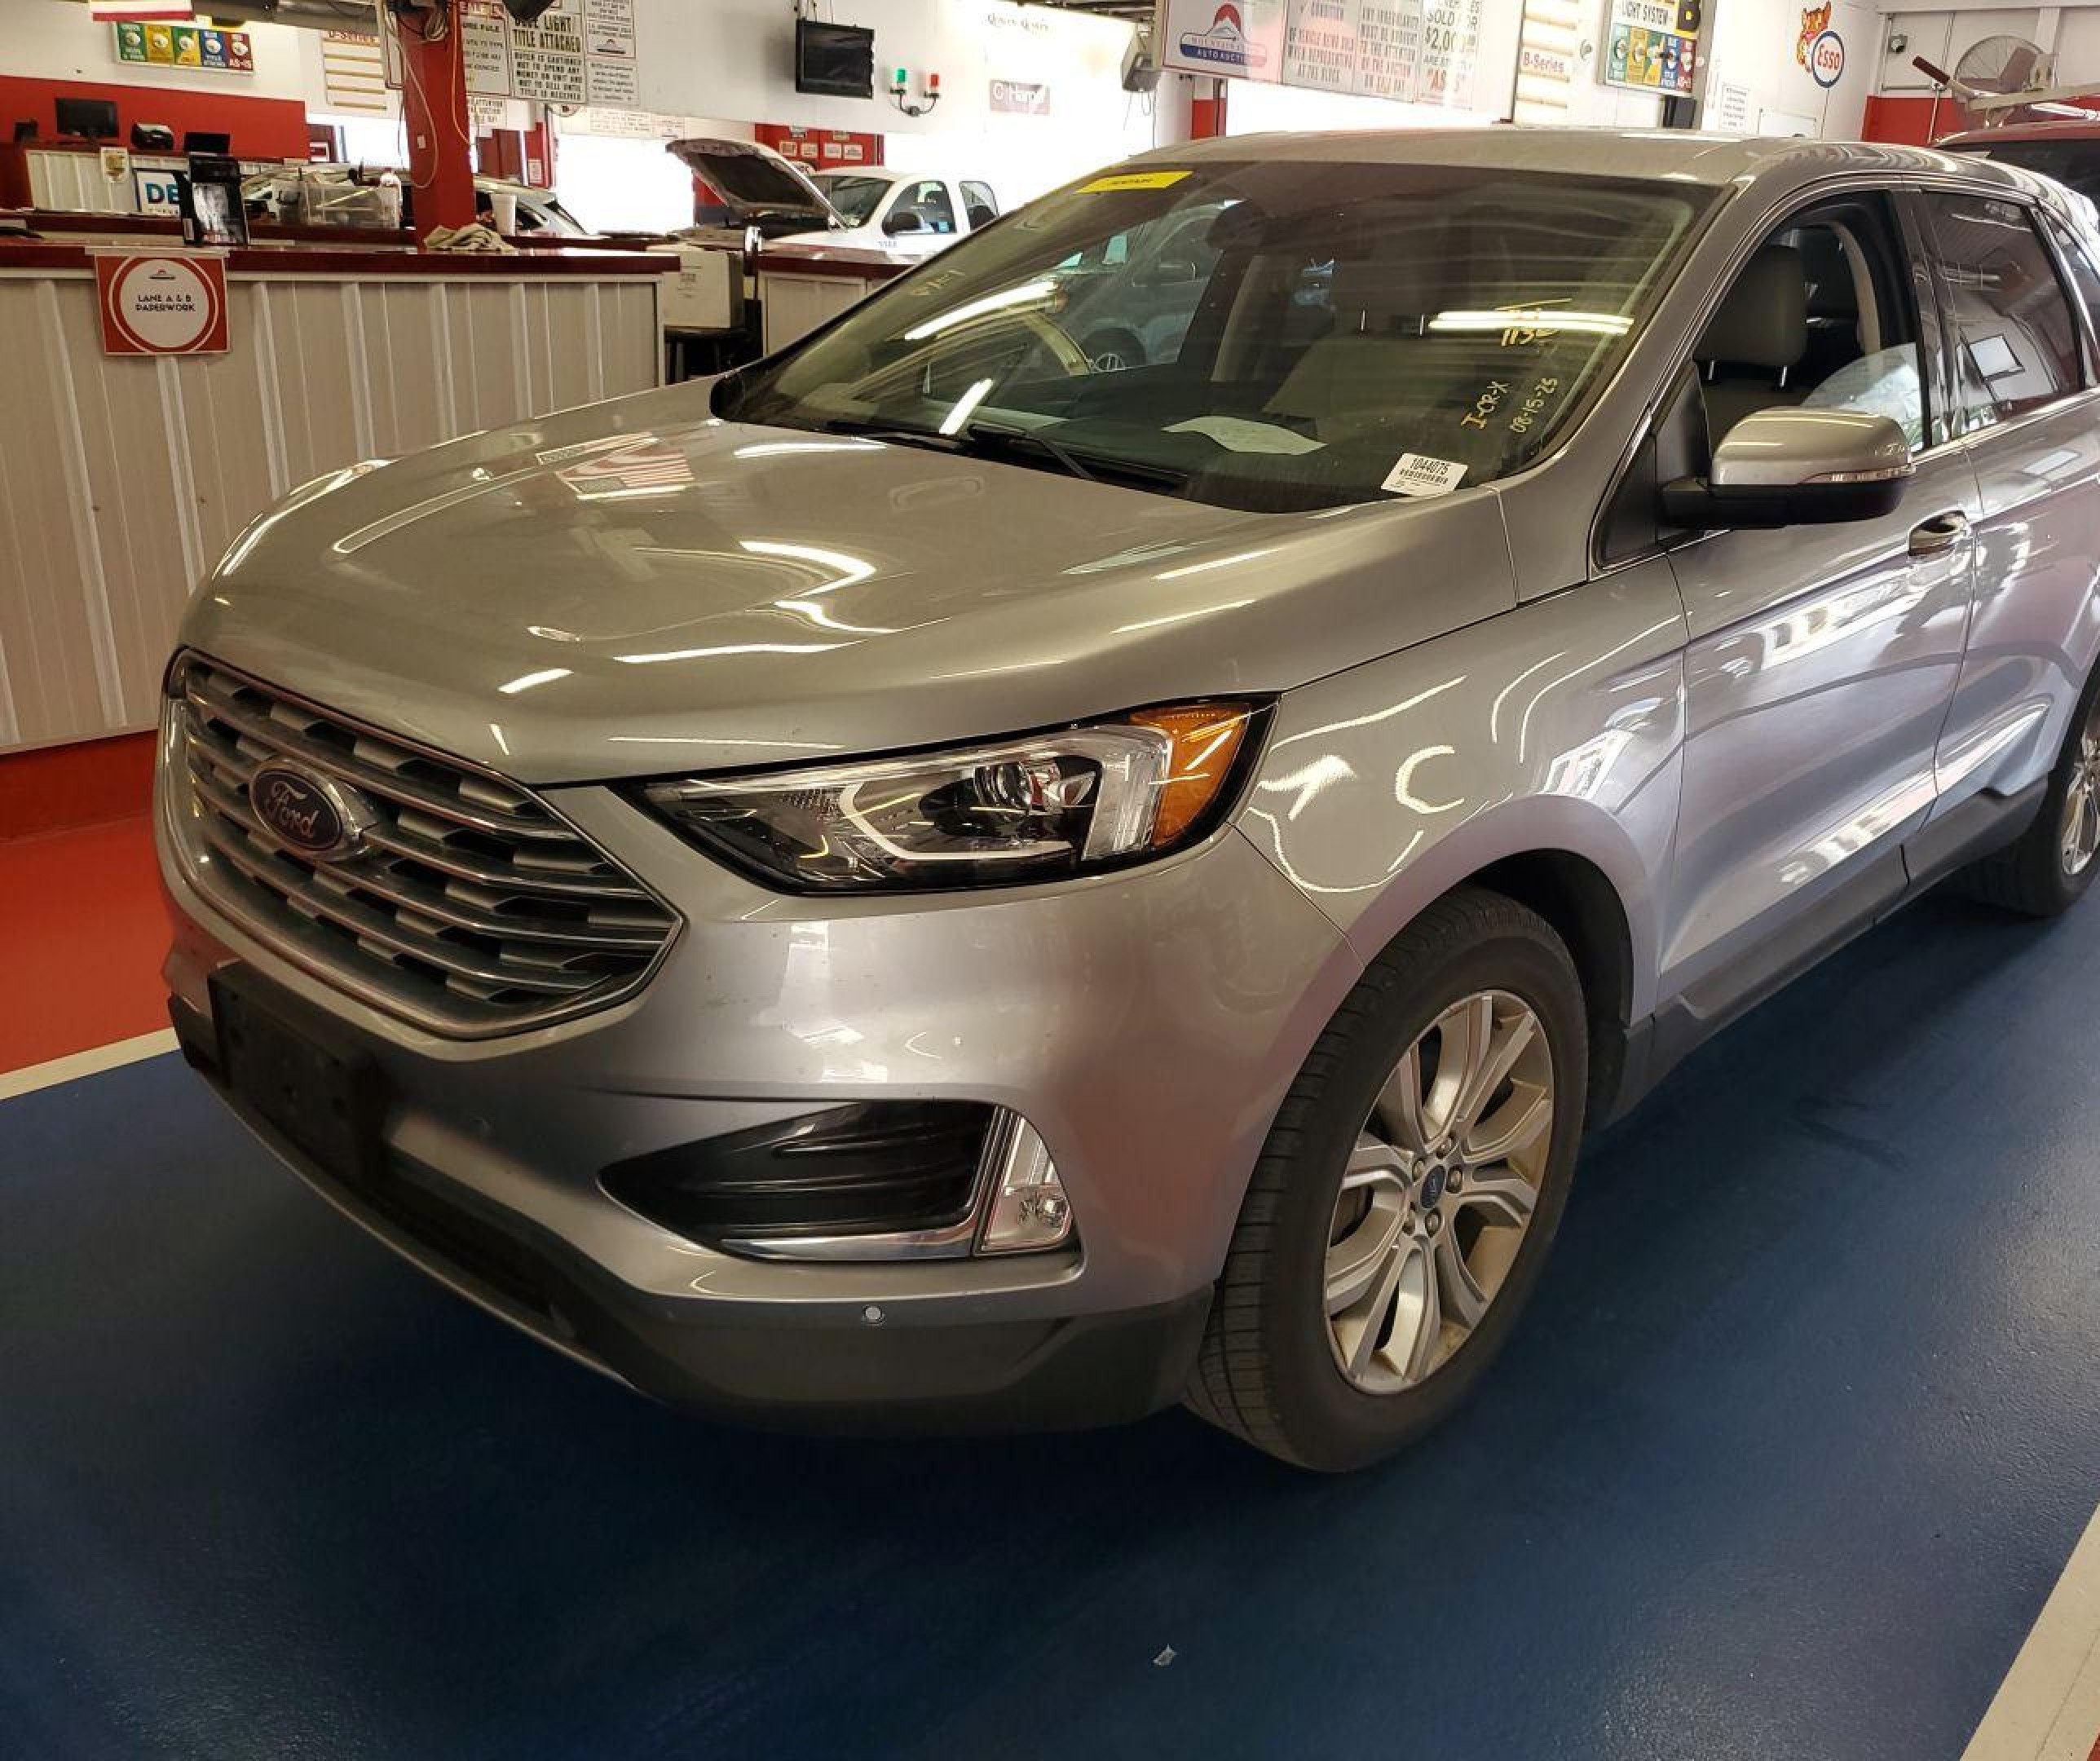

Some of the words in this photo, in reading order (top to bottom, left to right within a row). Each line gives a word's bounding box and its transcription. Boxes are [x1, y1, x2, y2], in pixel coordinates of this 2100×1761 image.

[544, 14, 572, 33] LIGHT
[1643, 4, 1669, 25] SYSTEM
[512, 29, 536, 47] TITLE
[539, 32, 581, 52] ATTACHED
[1522, 51, 1564, 73] B-Series
[135, 303, 196, 312] PAPERWORK
[138, 294, 162, 302] LANE
[165, 294, 174, 302] A
[264, 780, 320, 839] Ford
